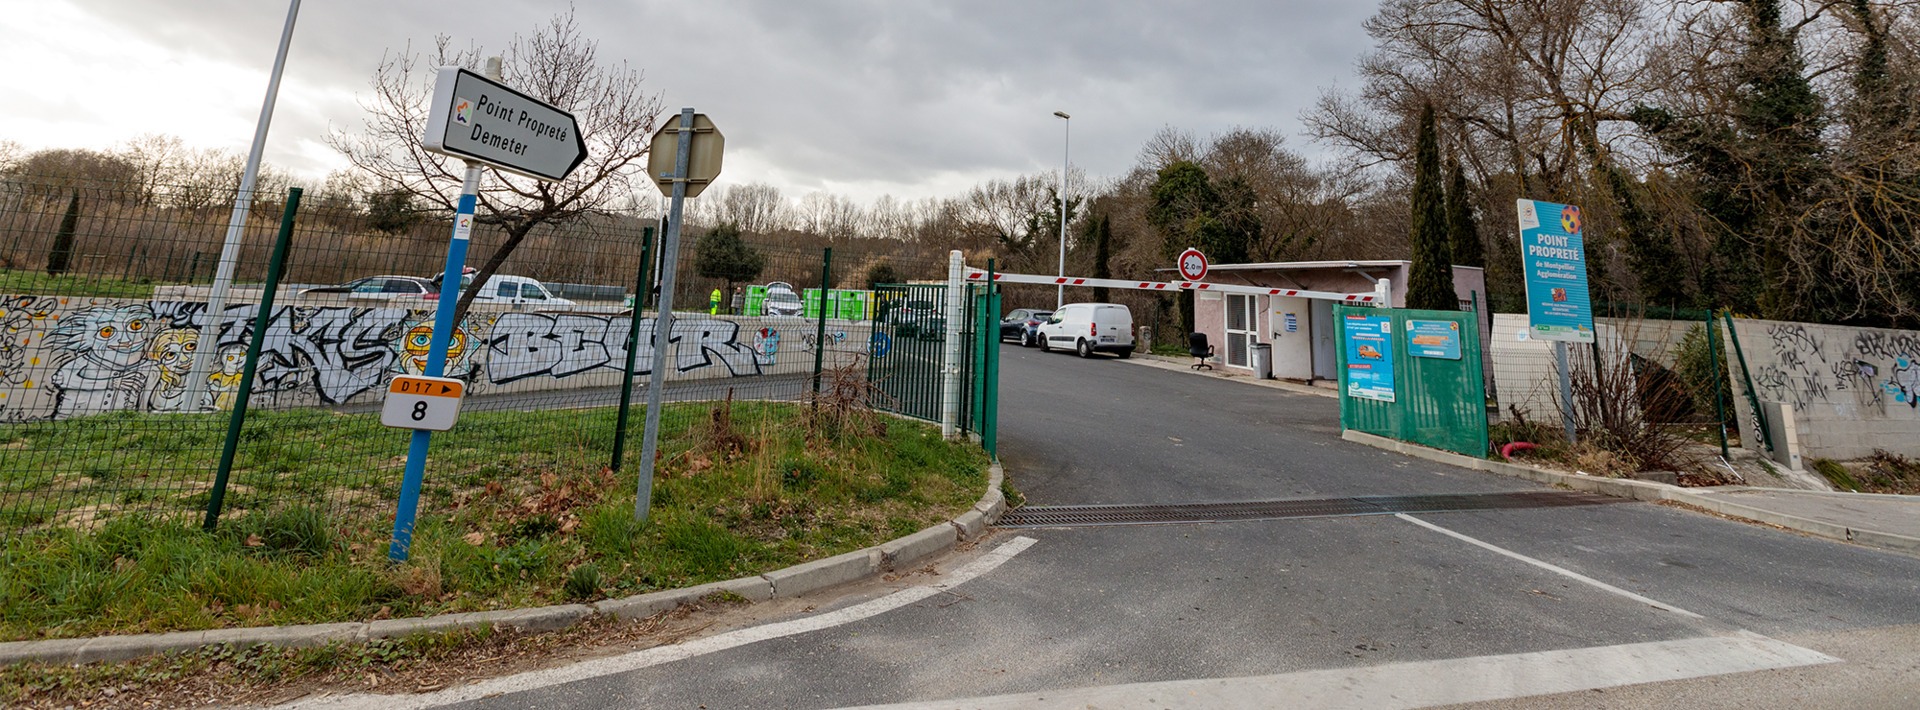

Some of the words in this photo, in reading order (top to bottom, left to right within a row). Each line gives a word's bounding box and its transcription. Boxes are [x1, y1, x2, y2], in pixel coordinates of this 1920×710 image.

[476, 94, 514, 122] Point
[518, 110, 568, 142] Propreté
[470, 123, 528, 156] Demeter
[1537, 233, 1569, 247] POINT
[1529, 245, 1580, 261] PROPRETÉ
[1544, 261, 1576, 271] Montpellier
[1536, 270, 1577, 280] Agglomération
[415, 382, 432, 393] 17
[411, 400, 428, 421] 8
